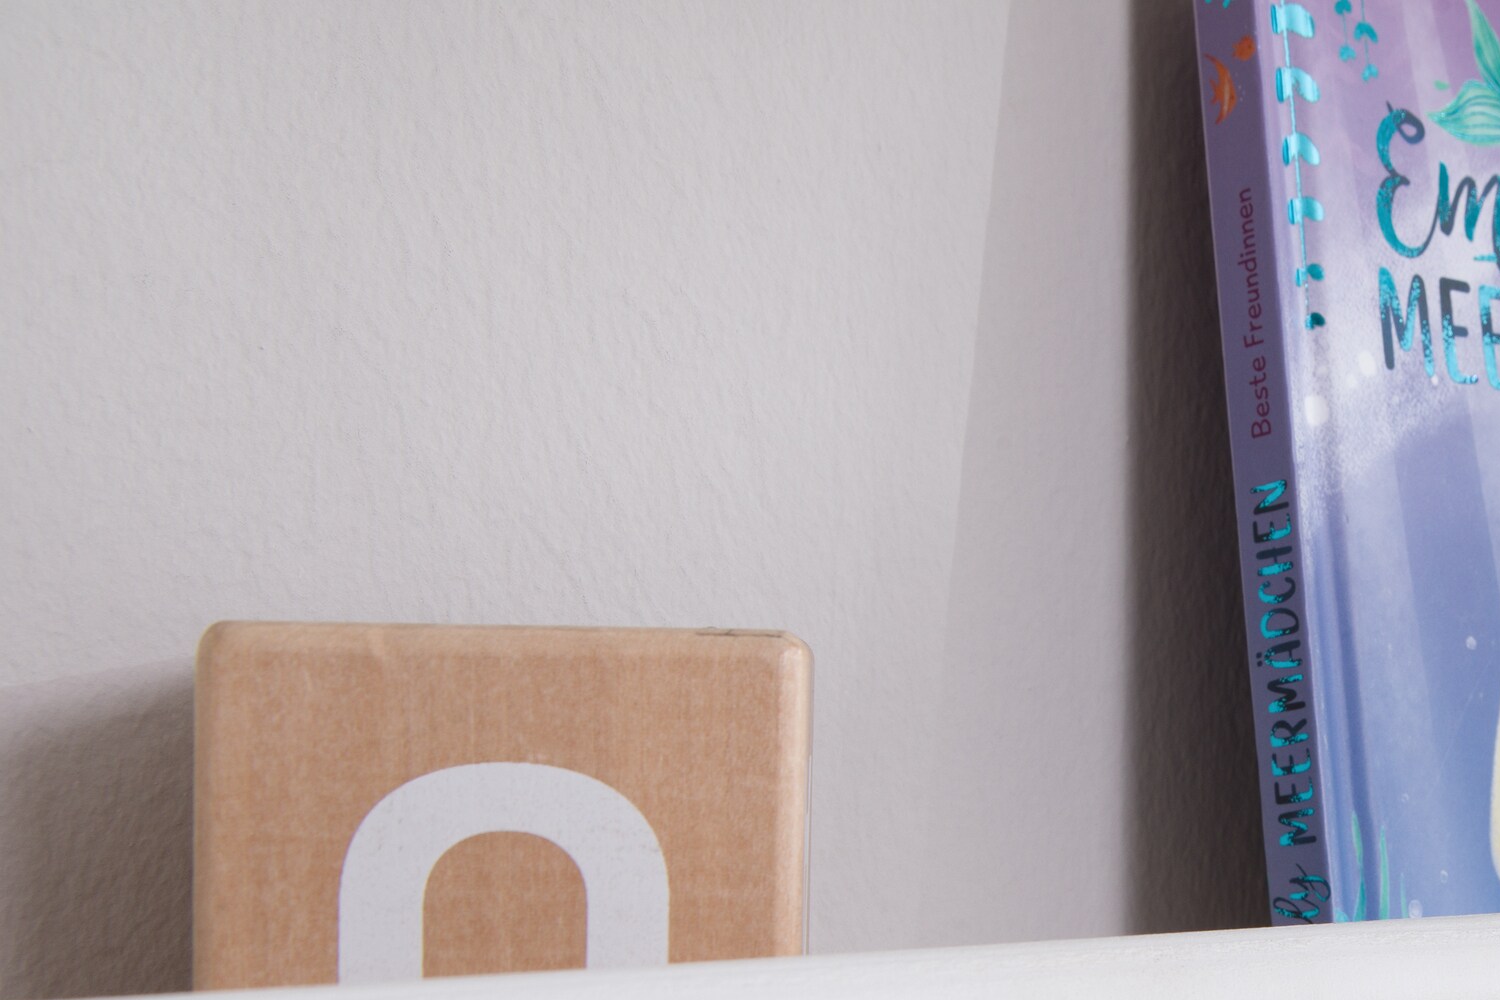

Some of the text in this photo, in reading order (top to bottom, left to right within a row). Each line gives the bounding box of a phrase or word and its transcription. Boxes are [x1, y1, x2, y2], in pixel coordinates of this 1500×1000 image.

[1238, 187, 1272, 439] Beste Freundinnen
[1250, 479, 1317, 847] MEERMÄDCHEN
